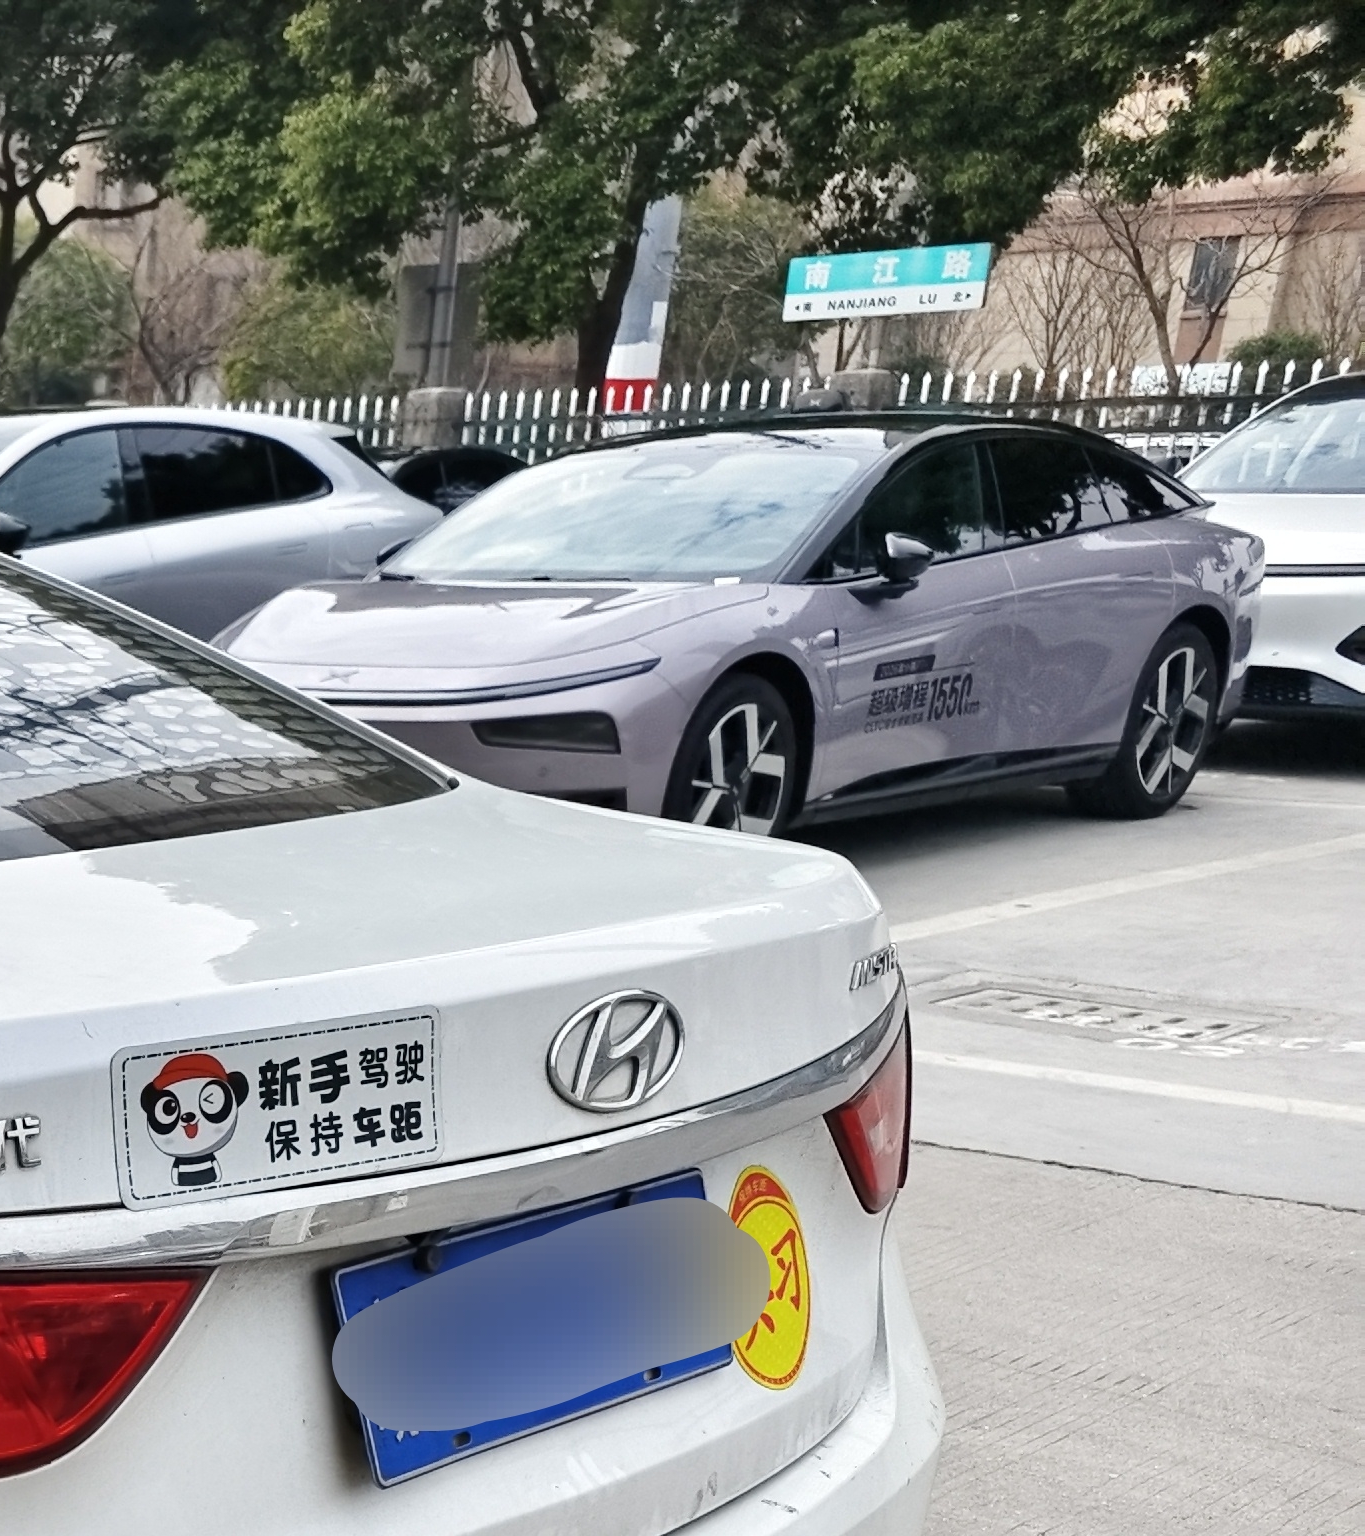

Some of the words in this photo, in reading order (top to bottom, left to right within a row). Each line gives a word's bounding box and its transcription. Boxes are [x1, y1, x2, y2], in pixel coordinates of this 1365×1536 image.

[805, 250, 972, 290] 南江路
[827, 297, 897, 311] NANJIANG
[919, 293, 937, 305] LU
[259, 1041, 425, 1110] 新手驾驶
[265, 1101, 424, 1163] 保持车距
